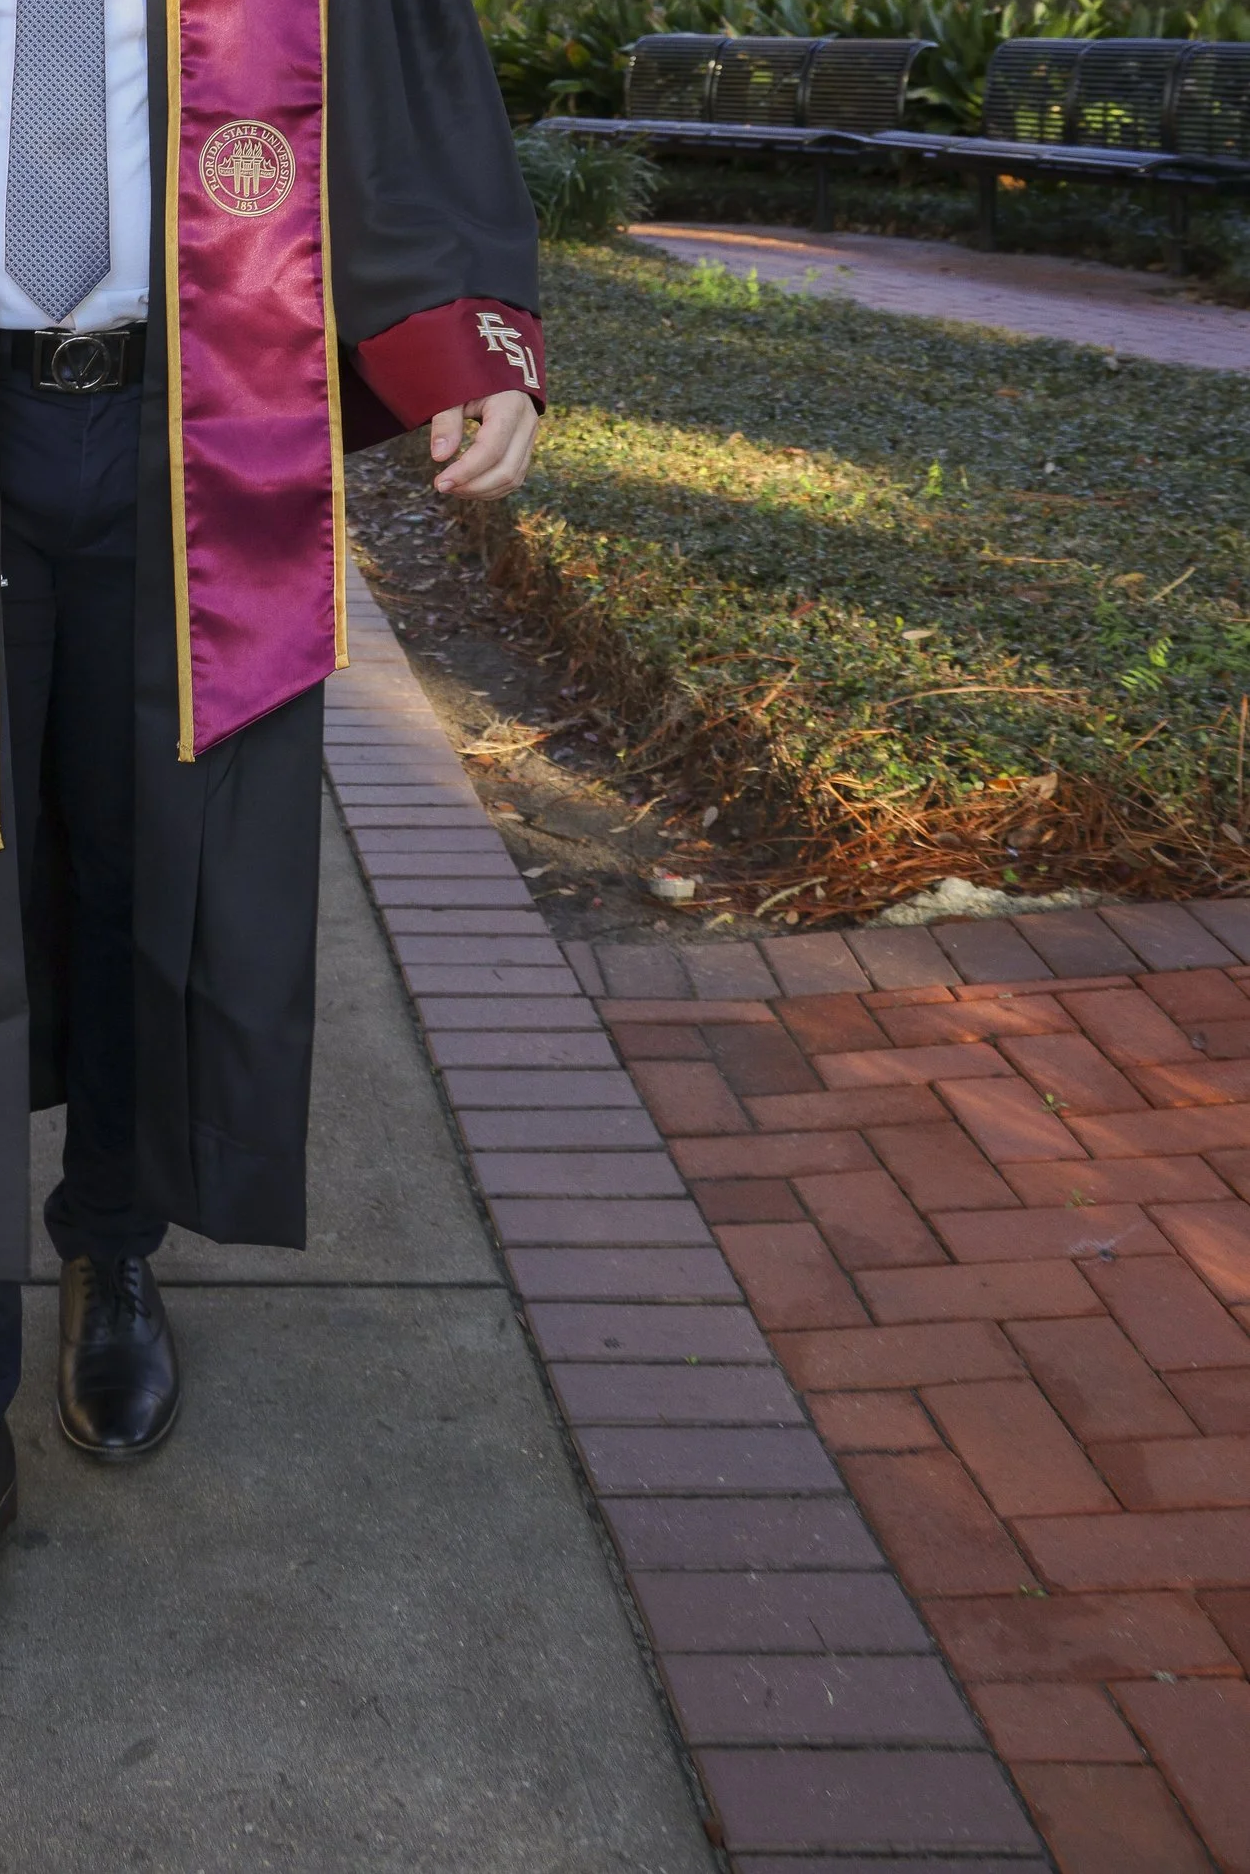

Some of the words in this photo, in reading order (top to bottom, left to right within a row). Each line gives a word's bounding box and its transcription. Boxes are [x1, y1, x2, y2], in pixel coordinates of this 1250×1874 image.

[205, 140, 224, 193] FLORIDA
[223, 126, 258, 141] STATE
[261, 129, 290, 196] UNIVERSITY
[235, 200, 259, 211] 1851
[475, 312, 541, 389] FSU
